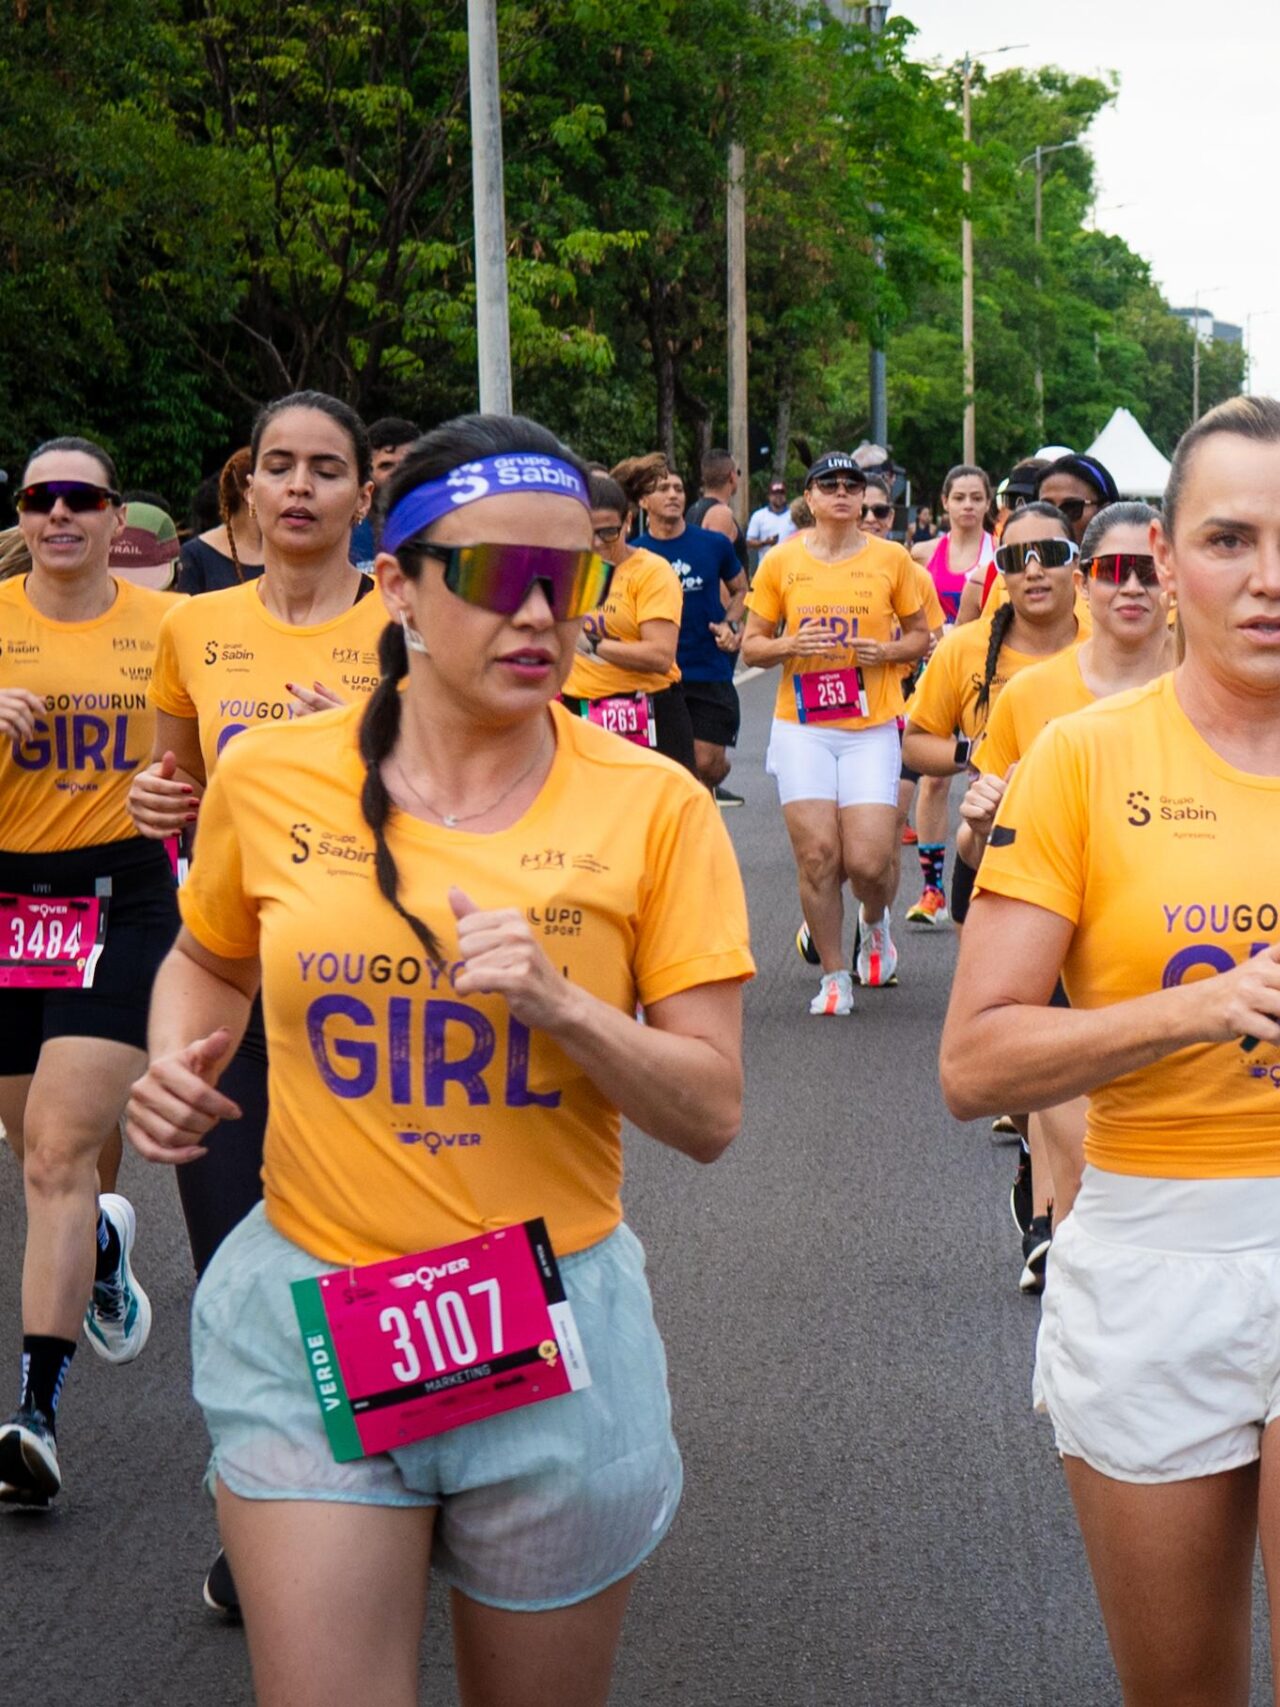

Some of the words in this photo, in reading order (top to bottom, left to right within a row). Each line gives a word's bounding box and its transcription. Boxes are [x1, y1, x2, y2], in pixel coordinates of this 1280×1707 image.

[494, 456, 552, 469] Grupo
[497, 466, 581, 492] Sabin
[797, 605, 869, 616] YOUGOYOURUN
[221, 650, 254, 661] Sabin
[342, 674, 379, 686] LUPO
[45, 694, 146, 710] GOYOURUN
[817, 681, 847, 707] 253
[220, 700, 294, 720] YOUGOY
[602, 708, 637, 732] 1263
[12, 714, 140, 771] GIRL
[1159, 805, 1218, 822] Sabin
[316, 841, 378, 865] Sabin
[527, 907, 582, 925] LUPO
[9, 917, 82, 960] 3484
[544, 924, 582, 937] SPORT
[298, 951, 492, 992] YOUGOYO
[306, 993, 562, 1109] GIRL
[398, 1131, 481, 1156] POWER
[389, 1258, 470, 1291] POWER
[379, 1277, 504, 1384] 3107
[307, 1334, 341, 1412] VERDE
[424, 1363, 492, 1393] MARKETING
